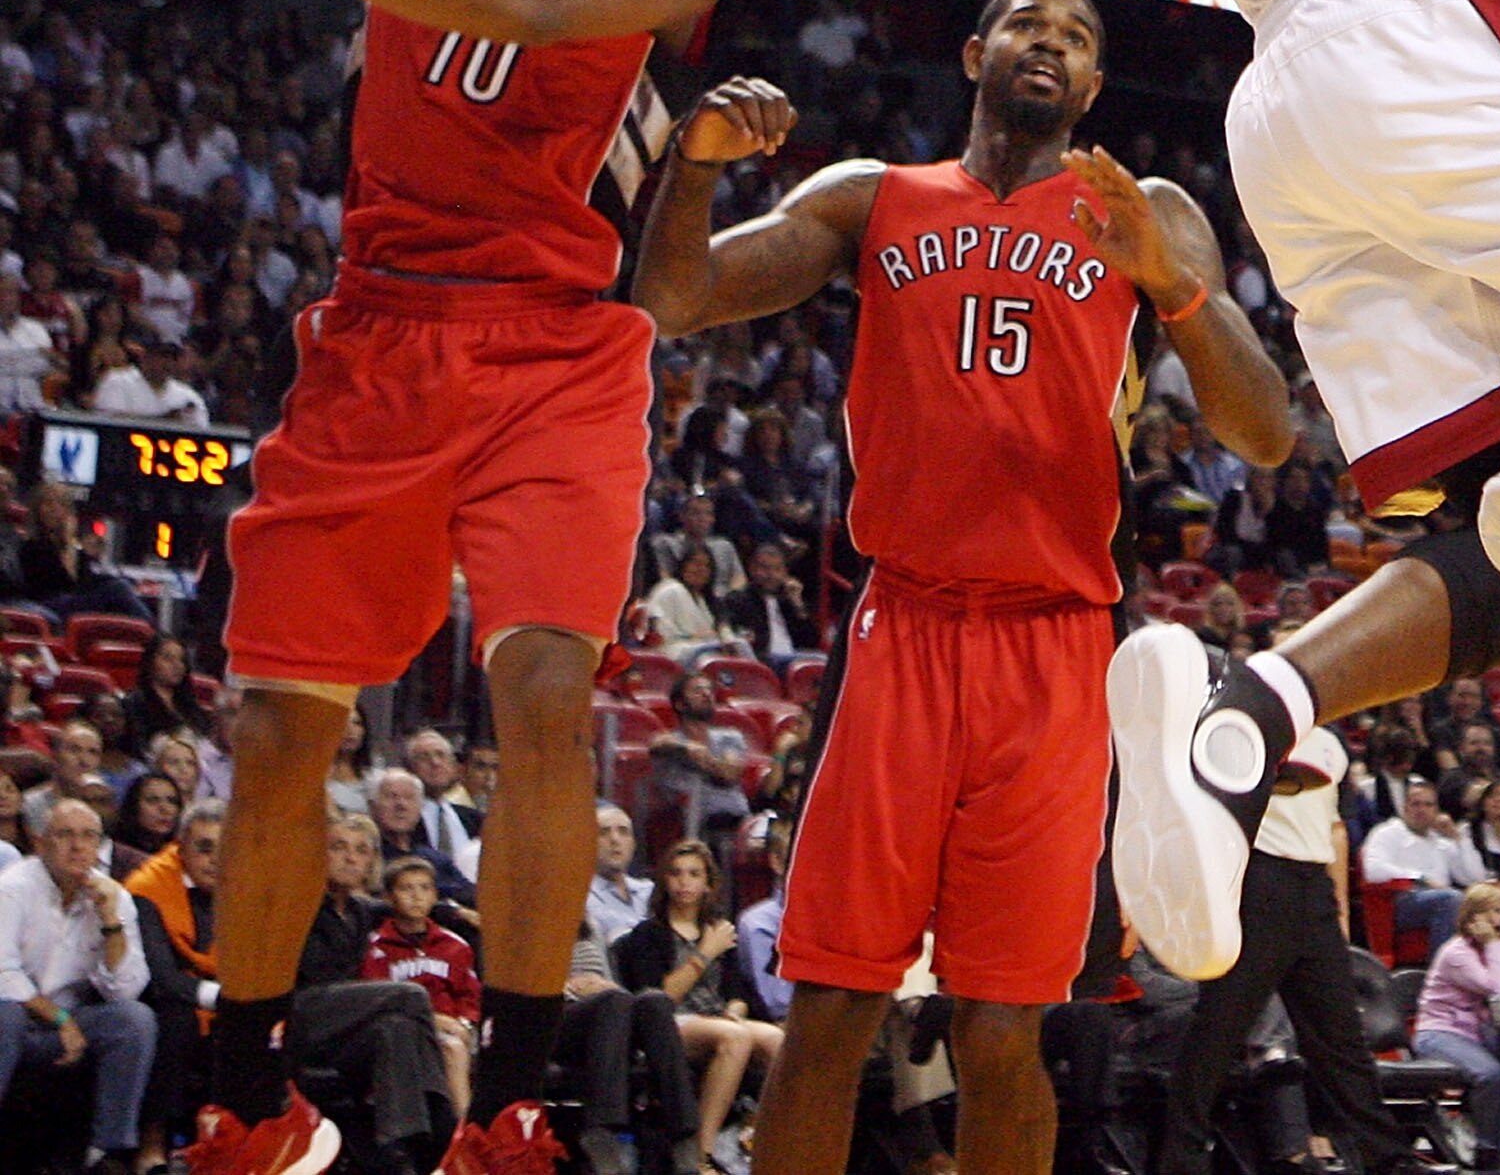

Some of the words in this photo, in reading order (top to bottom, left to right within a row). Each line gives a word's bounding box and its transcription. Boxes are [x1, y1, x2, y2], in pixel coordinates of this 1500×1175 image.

[427, 30, 523, 102] 10
[877, 224, 1106, 302] RAPTORS
[957, 293, 1034, 376] 15
[130, 433, 229, 486] 7:52
[156, 522, 172, 559] 1
